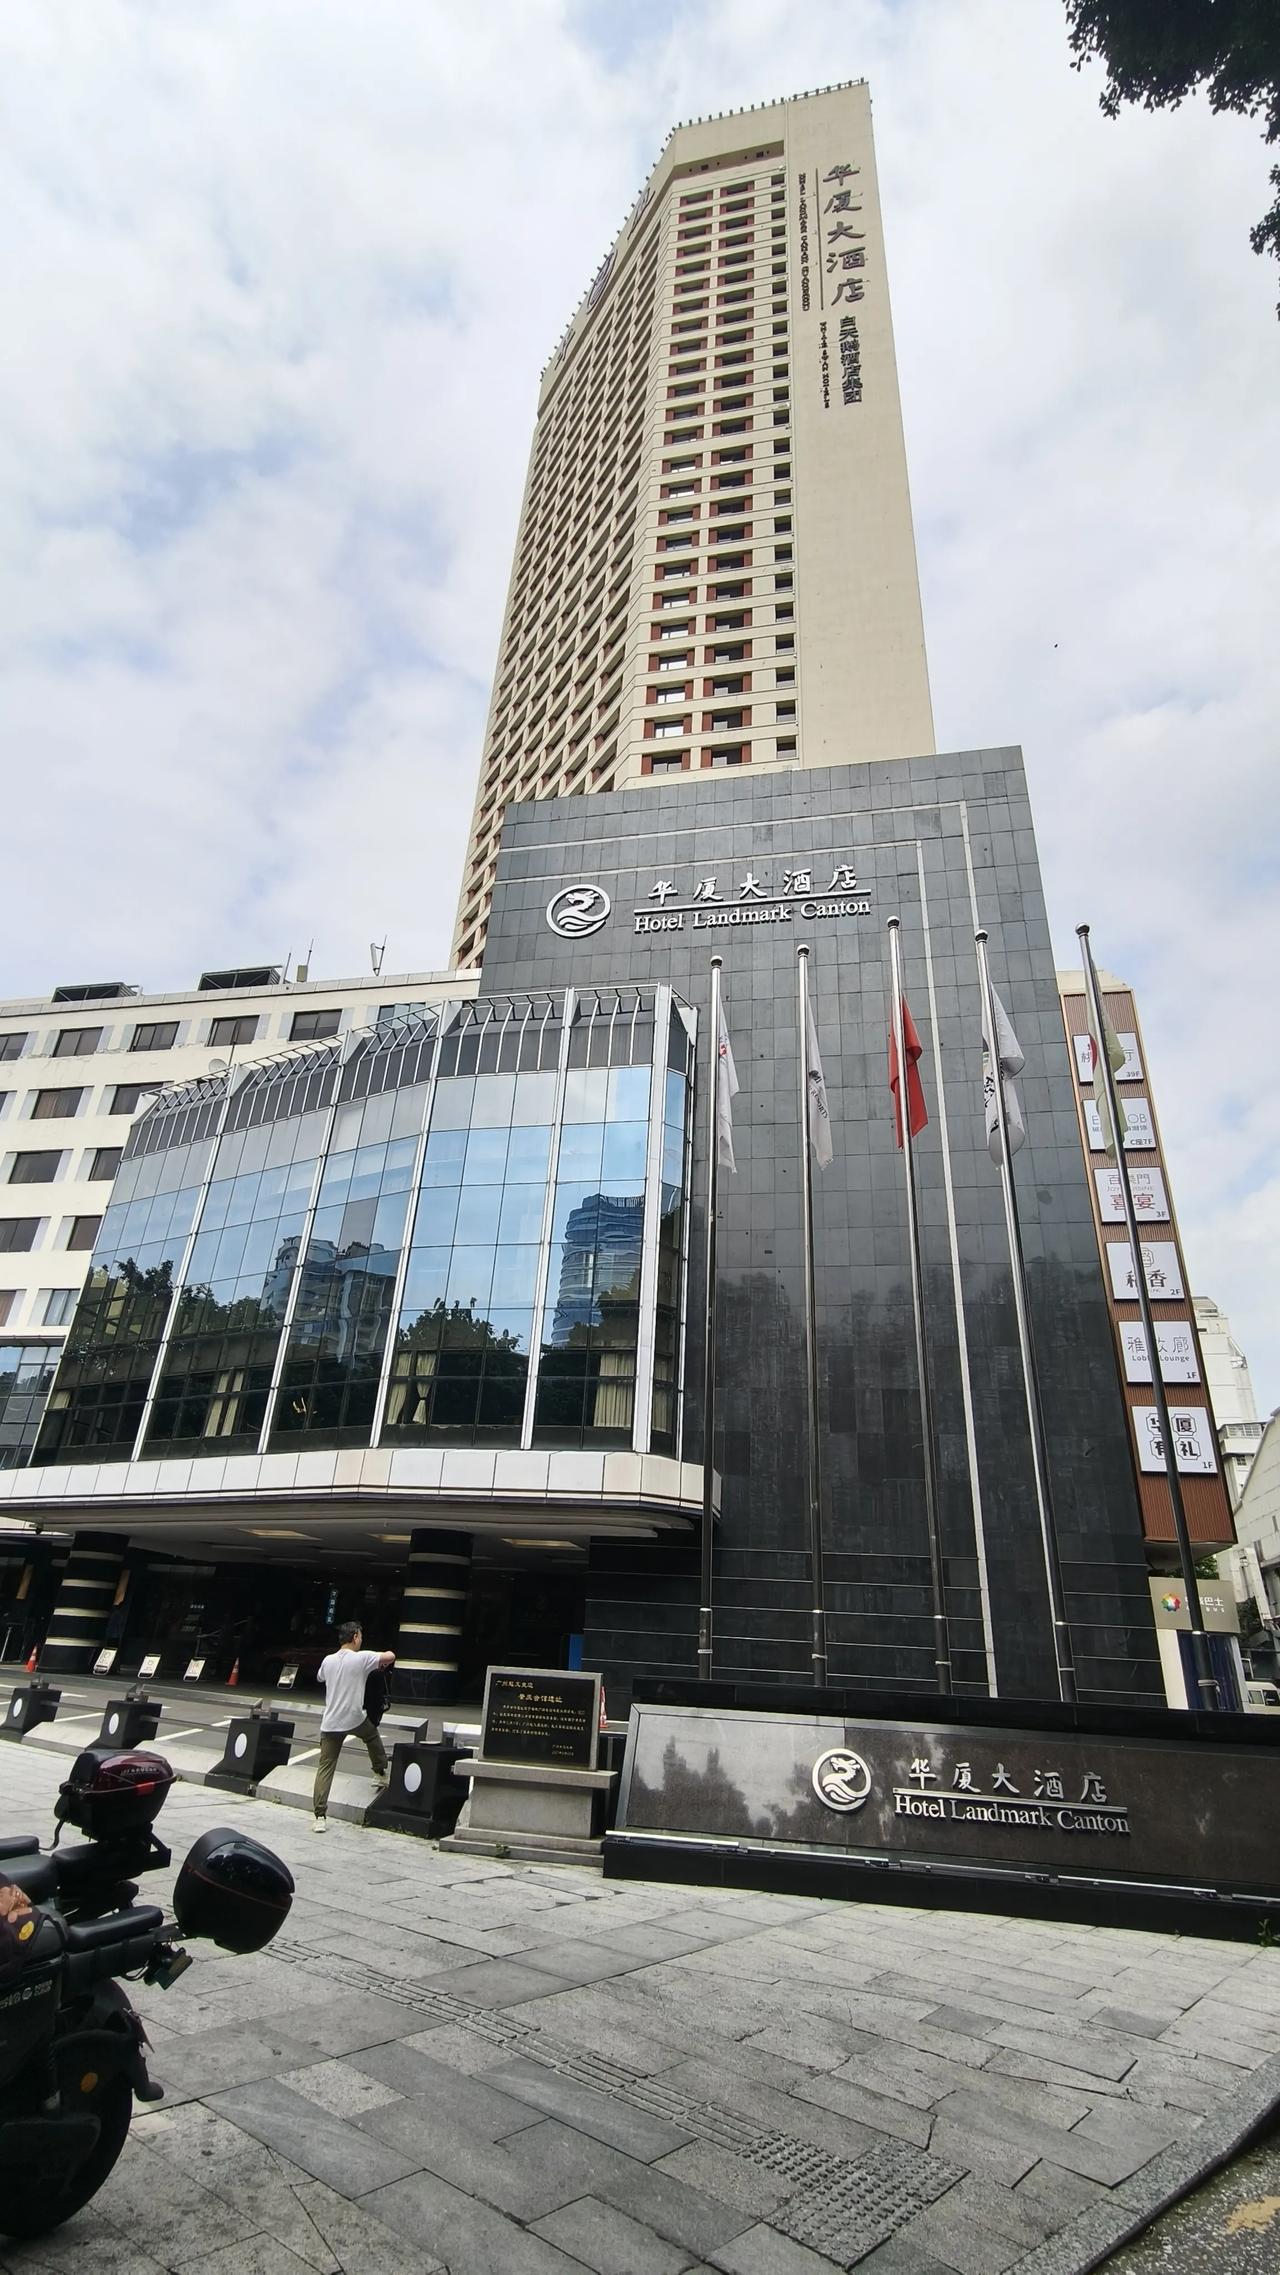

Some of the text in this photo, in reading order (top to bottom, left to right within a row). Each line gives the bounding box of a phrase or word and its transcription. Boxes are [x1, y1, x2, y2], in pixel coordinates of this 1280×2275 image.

[823, 163, 866, 306] 华厦大酒店
[648, 864, 859, 906] 华厦大酒店
[634, 899, 871, 934] Hotel Landmark Canton
[1156, 1210, 1166, 1218] 3F
[1170, 1288, 1181, 1296] 2F
[1160, 1355, 1190, 1363] Lounge
[1186, 1371, 1197, 1379] 1F
[1203, 1461, 1213, 1469] 1F
[908, 1758, 1109, 1803] 华厦大酒店
[893, 1794, 1131, 1833] Hotel Landmark Canton
